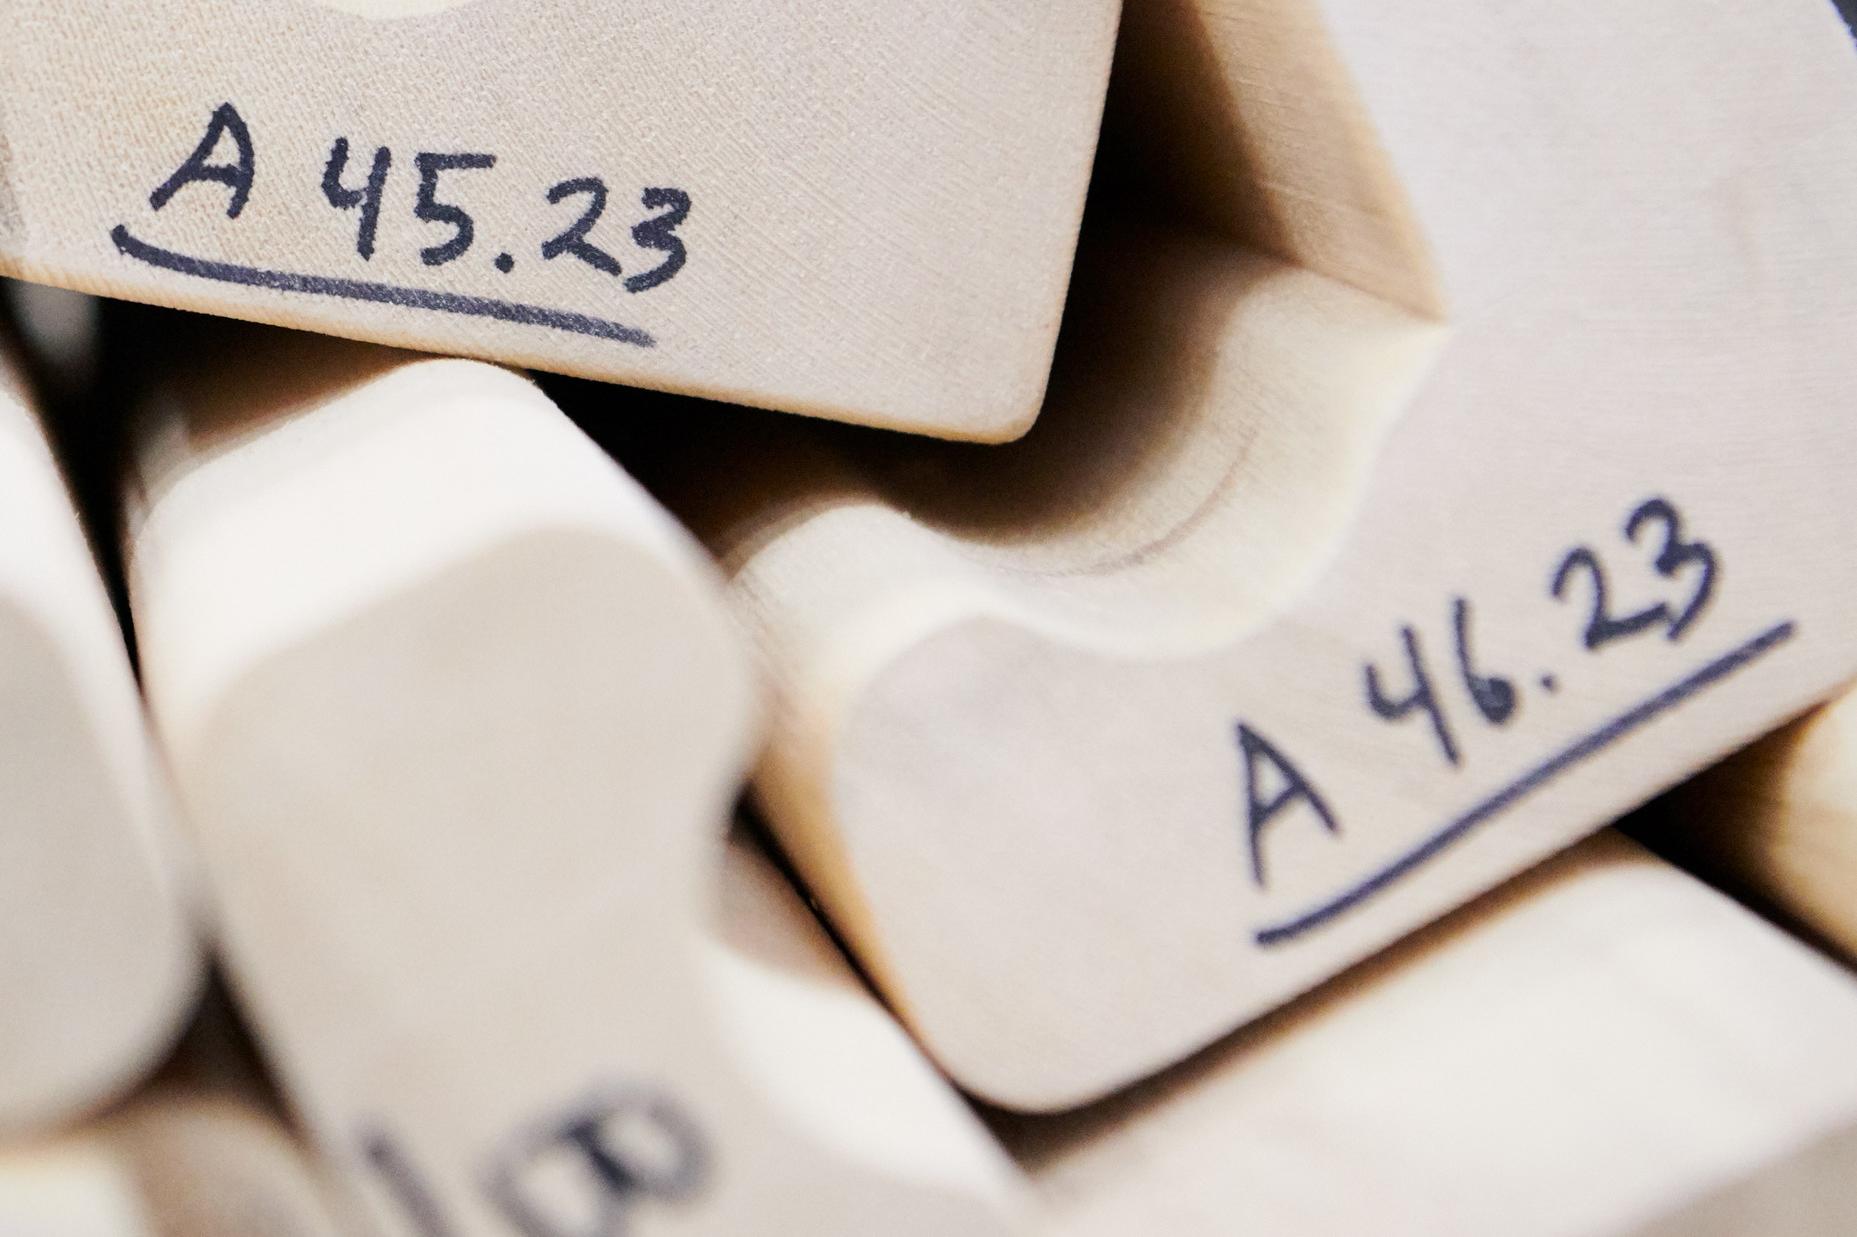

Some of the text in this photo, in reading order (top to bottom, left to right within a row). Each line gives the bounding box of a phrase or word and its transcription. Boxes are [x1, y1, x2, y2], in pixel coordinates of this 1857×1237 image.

[149, 102, 692, 294] A 45.23
[1236, 495, 1718, 888] A 46.23
